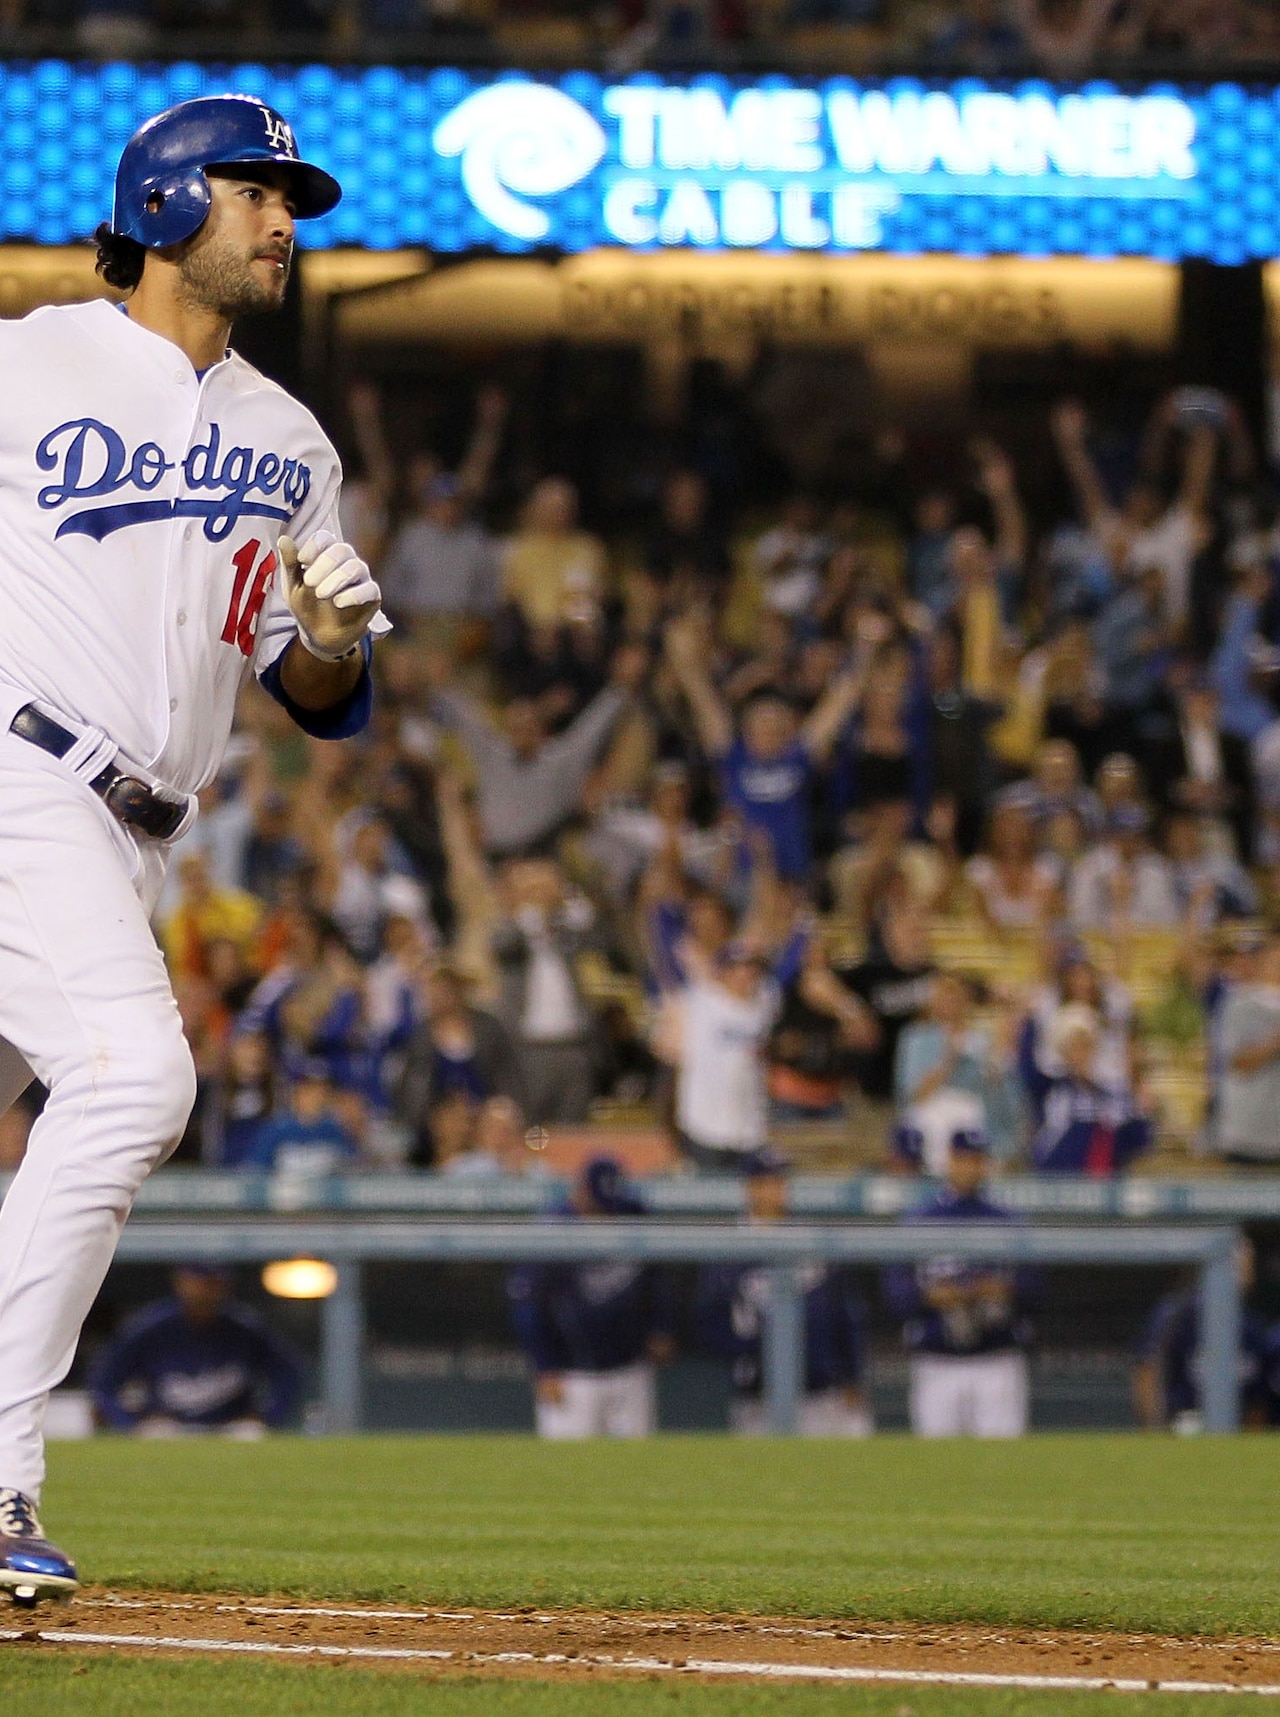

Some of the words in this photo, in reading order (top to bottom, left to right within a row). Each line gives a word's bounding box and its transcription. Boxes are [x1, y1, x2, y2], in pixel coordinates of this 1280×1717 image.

[258, 107, 294, 158] LA
[604, 85, 823, 171] TIME
[827, 90, 1198, 180] WARNER
[604, 178, 884, 249] CABLE
[35, 416, 312, 543] Dodgers
